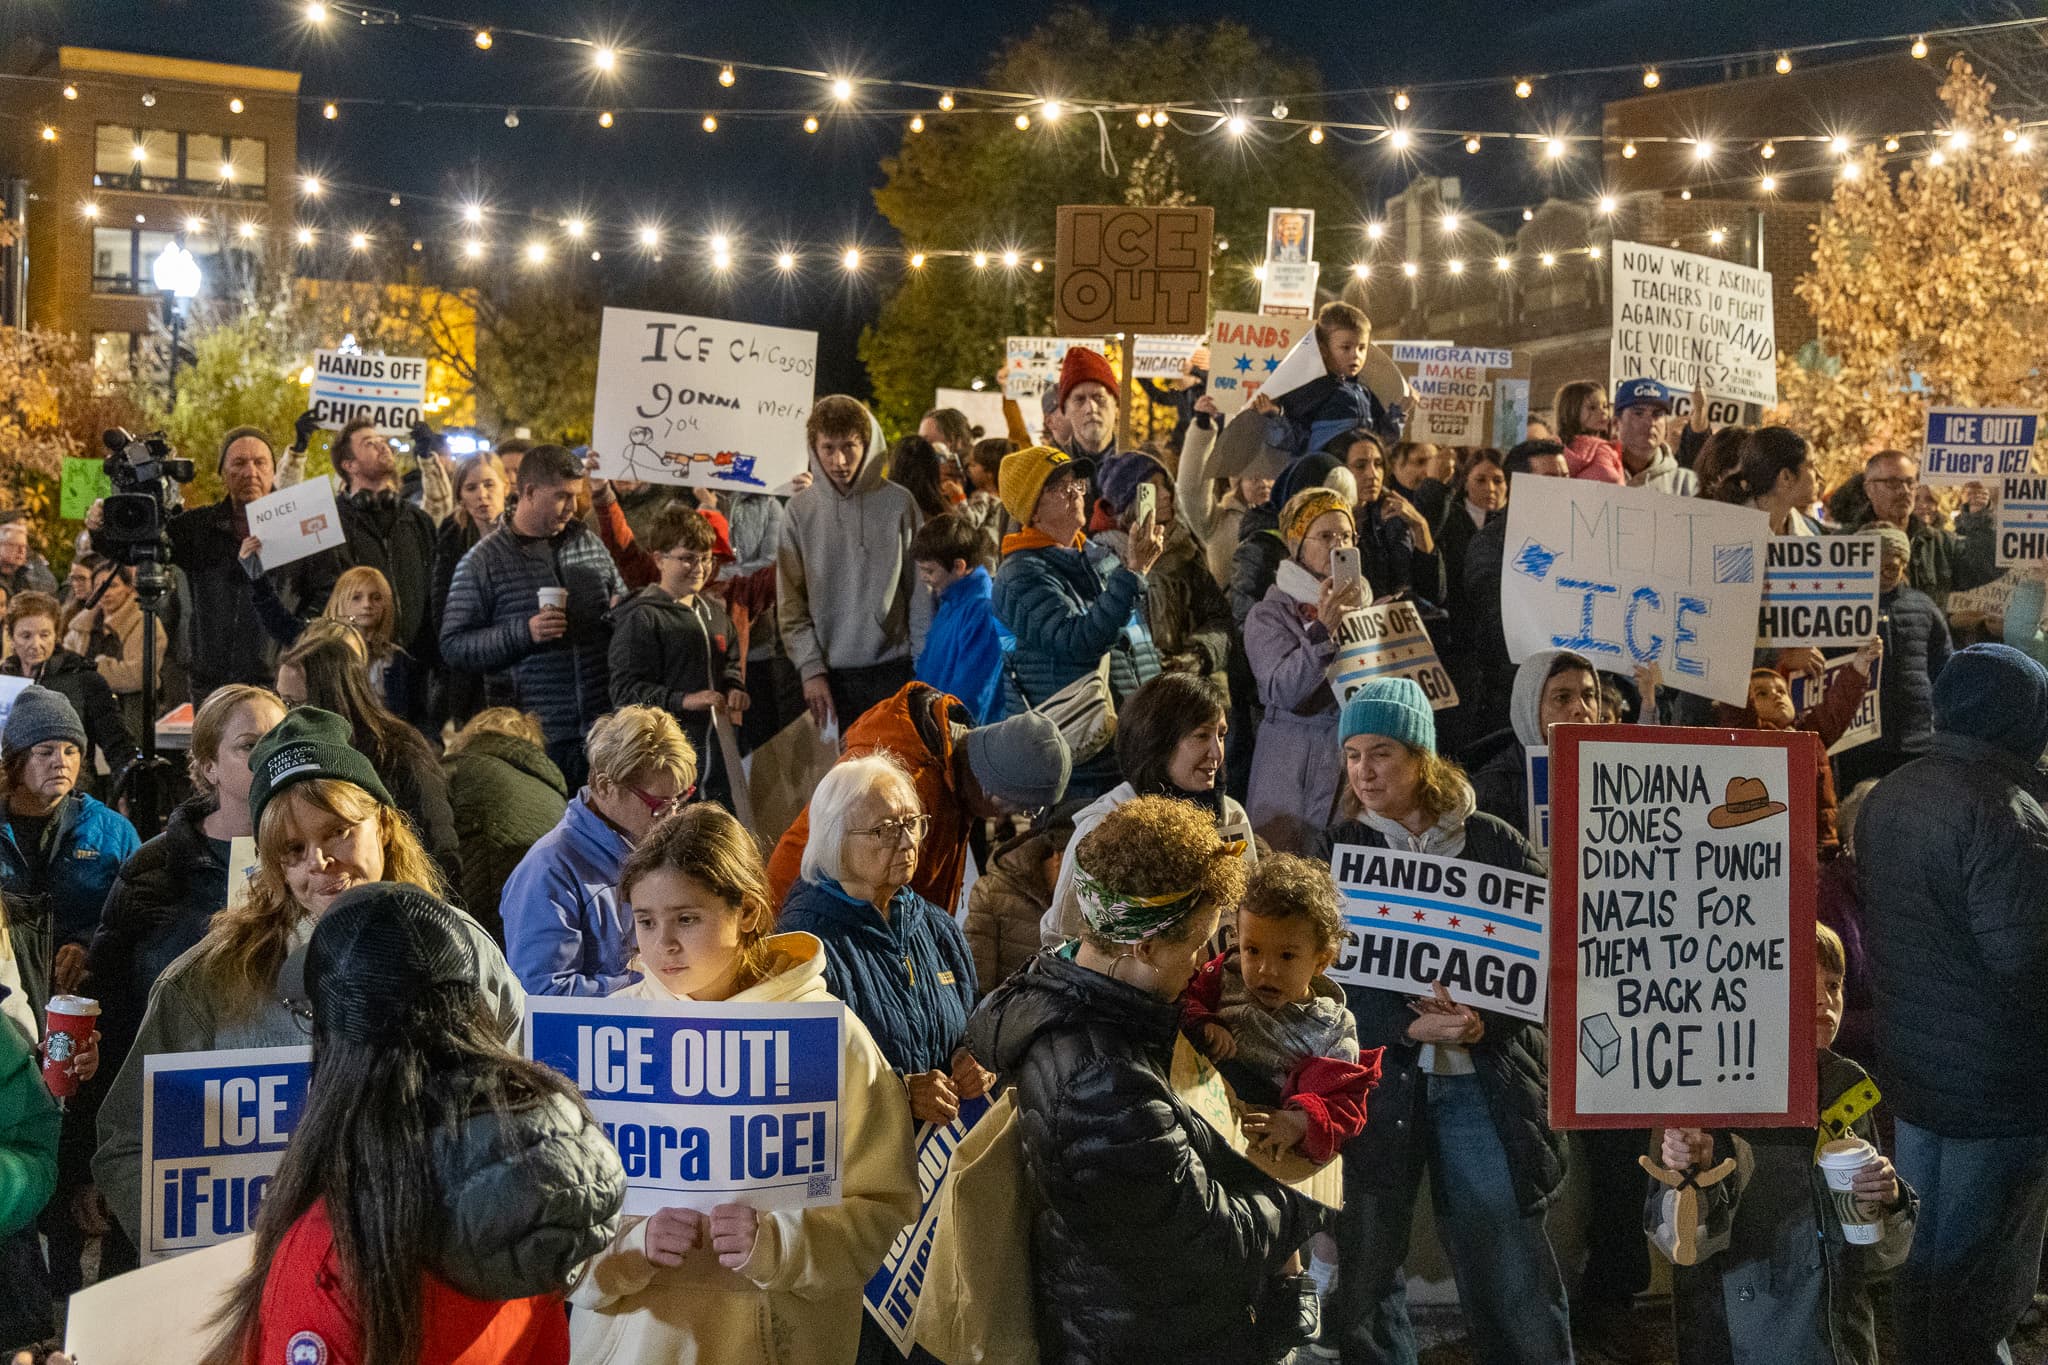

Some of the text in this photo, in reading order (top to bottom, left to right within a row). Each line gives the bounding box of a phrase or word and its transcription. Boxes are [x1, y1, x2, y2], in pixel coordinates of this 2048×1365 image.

[1072, 212, 1198, 268] ICE
[1623, 252, 1664, 276] NOW
[1718, 270, 1766, 298] ASKING
[1061, 268, 1202, 325] OUT
[1632, 279, 1703, 308] TEACHERS
[1728, 297, 1766, 323] FIGHT
[641, 323, 713, 363] ICE
[1217, 321, 1290, 349] HANDS
[1618, 329, 1726, 366] ICE VIOLENCE
[1621, 303, 1773, 361] AGAINST GUN AND
[318, 354, 422, 380] HANDS OFF
[1396, 346, 1510, 367] IMMIGRANTS
[1426, 364, 1477, 380] MAKE
[1623, 355, 1642, 377] IN
[1215, 376, 1237, 390] OUR
[1411, 380, 1490, 398] AMERICA
[1417, 397, 1481, 414] GREAT!
[1945, 416, 2022, 443] ICE OUT!
[1998, 449, 2030, 474] ICE!
[255, 500, 297, 524] NO ICE!
[1571, 500, 1711, 586] MELT
[1766, 542, 1875, 567] NDS OFF
[2002, 532, 2048, 560] CHI
[1335, 607, 1419, 646] ANDS OFF
[1552, 577, 1711, 680] ICE
[1758, 605, 1873, 638] HICAGO
[267, 746, 316, 767] CHICAGO
[269, 752, 305, 772] PUBLIC
[270, 756, 313, 779] LIBRARY
[1592, 761, 1711, 805] INDIANA
[1585, 806, 1683, 844] JONES
[1583, 841, 1782, 881] DIDN'T PUNCH
[1340, 852, 1546, 915] HANDS OFF
[1582, 887, 1756, 934] NAZIS FOR
[1331, 930, 1537, 1006] CHICAGO
[1579, 934, 1785, 977] THEM TO COME
[1618, 977, 1747, 1017] BACK AS
[577, 1025, 790, 1098] ICE OUT!
[1631, 1022, 1702, 1089] ICE
[204, 1075, 288, 1148] ICE
[729, 1111, 826, 1181] ICE!
